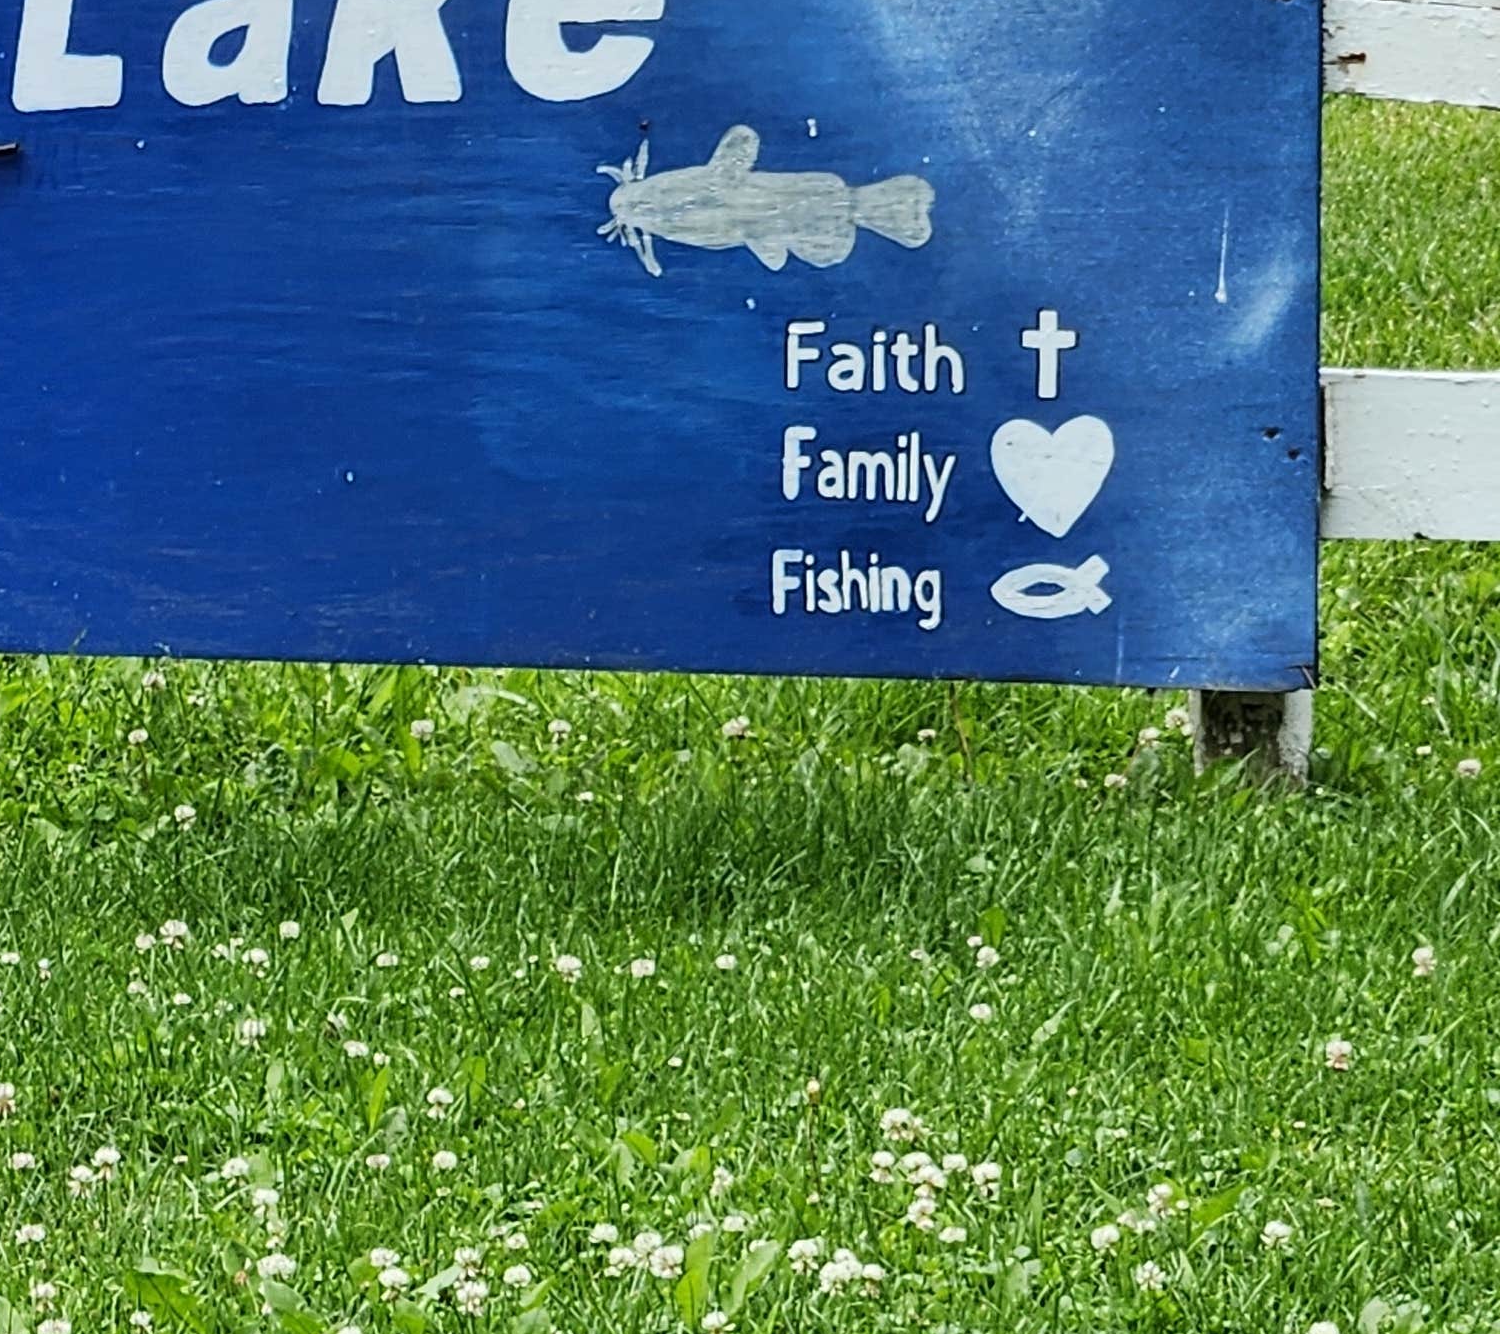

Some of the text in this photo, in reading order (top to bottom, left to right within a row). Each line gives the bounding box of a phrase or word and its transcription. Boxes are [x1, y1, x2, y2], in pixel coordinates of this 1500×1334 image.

[786, 320, 965, 395] Faith
[782, 425, 957, 524] Family
[771, 548, 942, 631] Fishing
